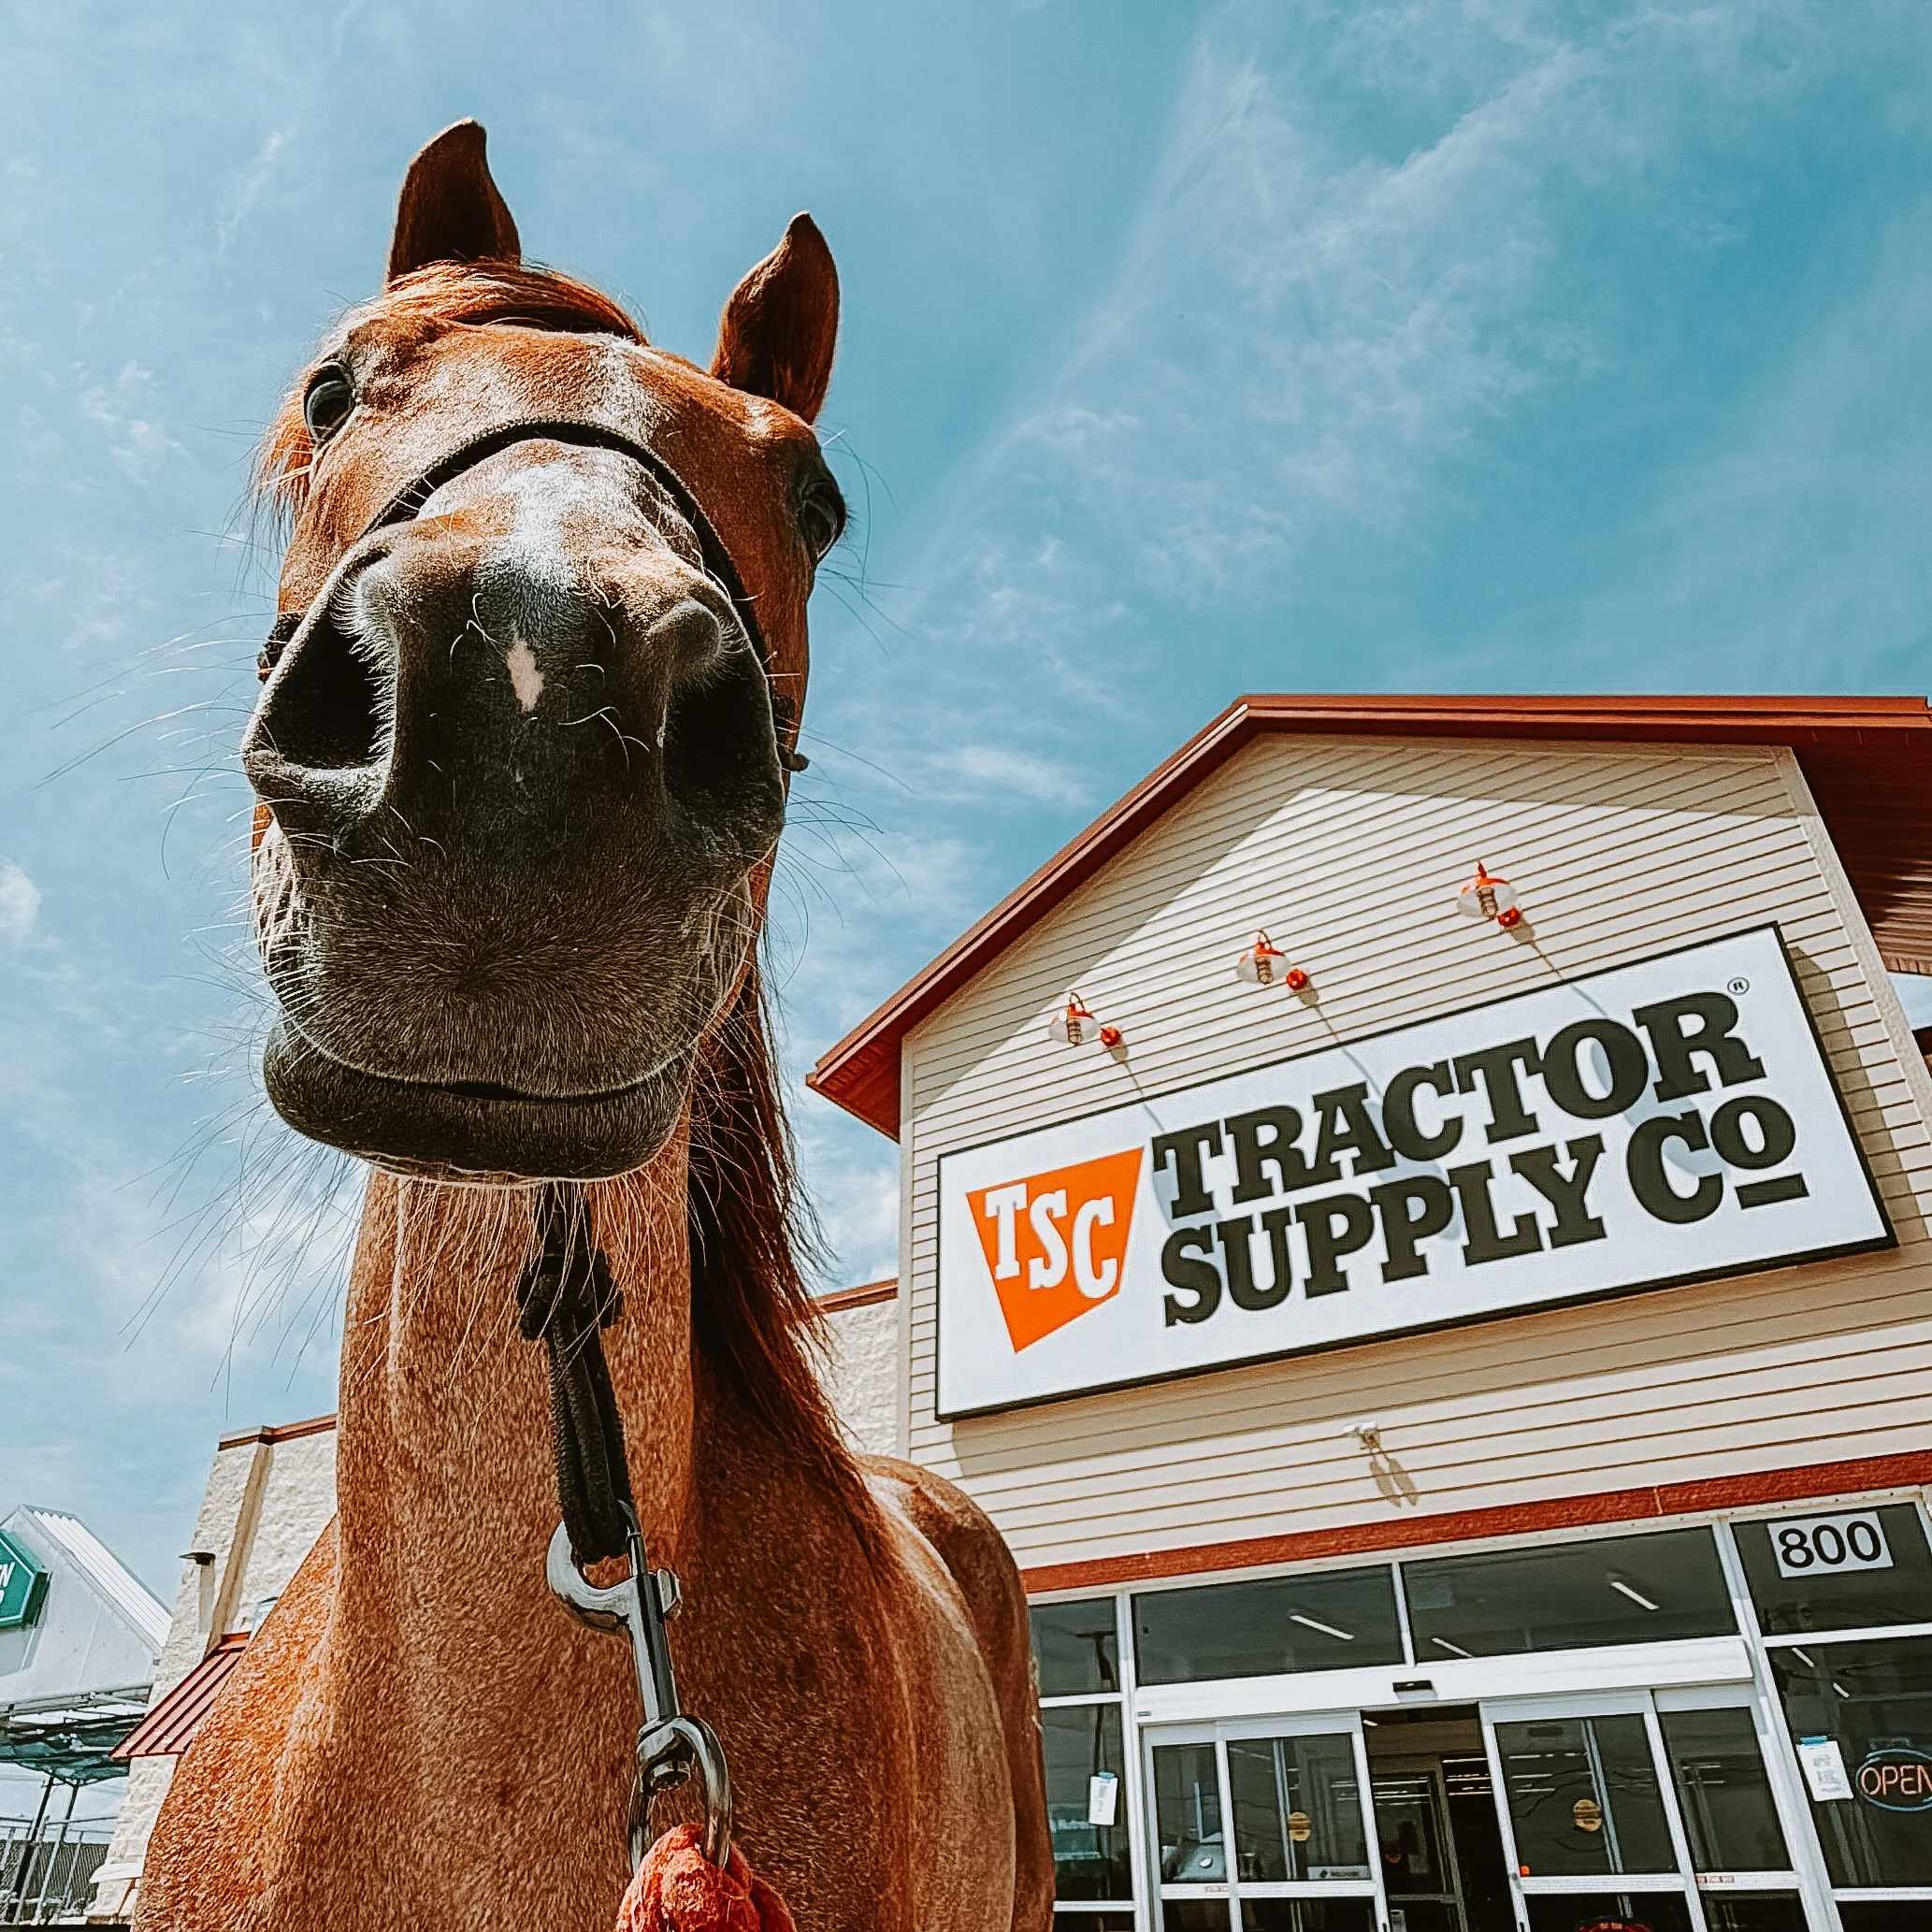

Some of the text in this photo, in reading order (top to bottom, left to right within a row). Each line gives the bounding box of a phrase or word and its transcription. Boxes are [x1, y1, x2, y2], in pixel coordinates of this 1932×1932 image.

[1152, 992, 1766, 1219] TRACTOR
[986, 1183, 1117, 1299] TSC
[1161, 1133, 1607, 1327] SUPPLY
[1779, 1521, 1881, 1568] 800
